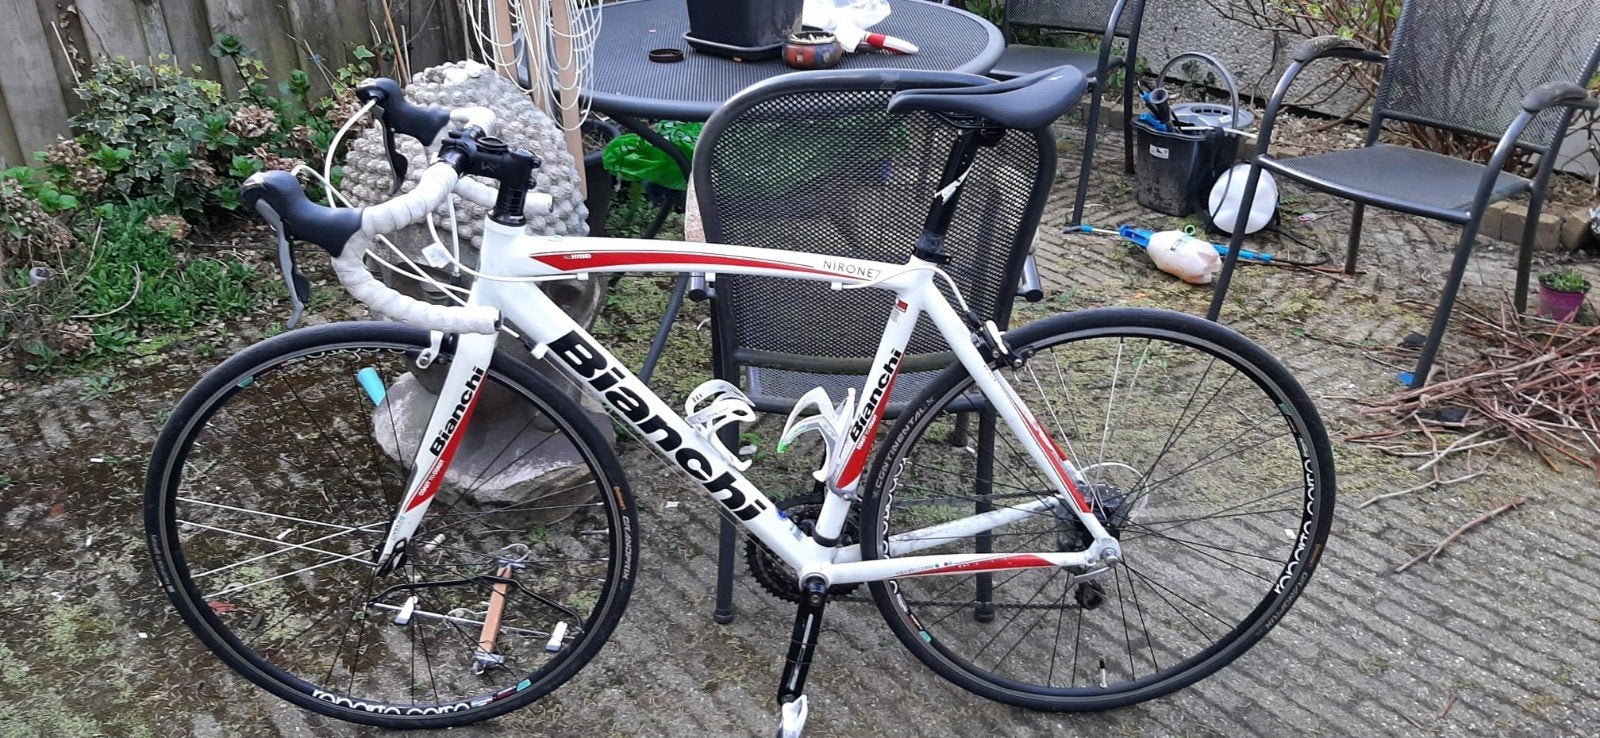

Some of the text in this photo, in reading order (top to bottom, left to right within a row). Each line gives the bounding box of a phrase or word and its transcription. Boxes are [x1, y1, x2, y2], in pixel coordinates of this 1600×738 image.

[429, 365, 485, 457] Bianchi
[547, 330, 768, 521] Bianchi
[850, 348, 902, 443] Bianchi
[418, 480, 432, 496] COAST
[434, 459, 445, 475] COAST
[875, 406, 928, 488] CONTINENTAL
